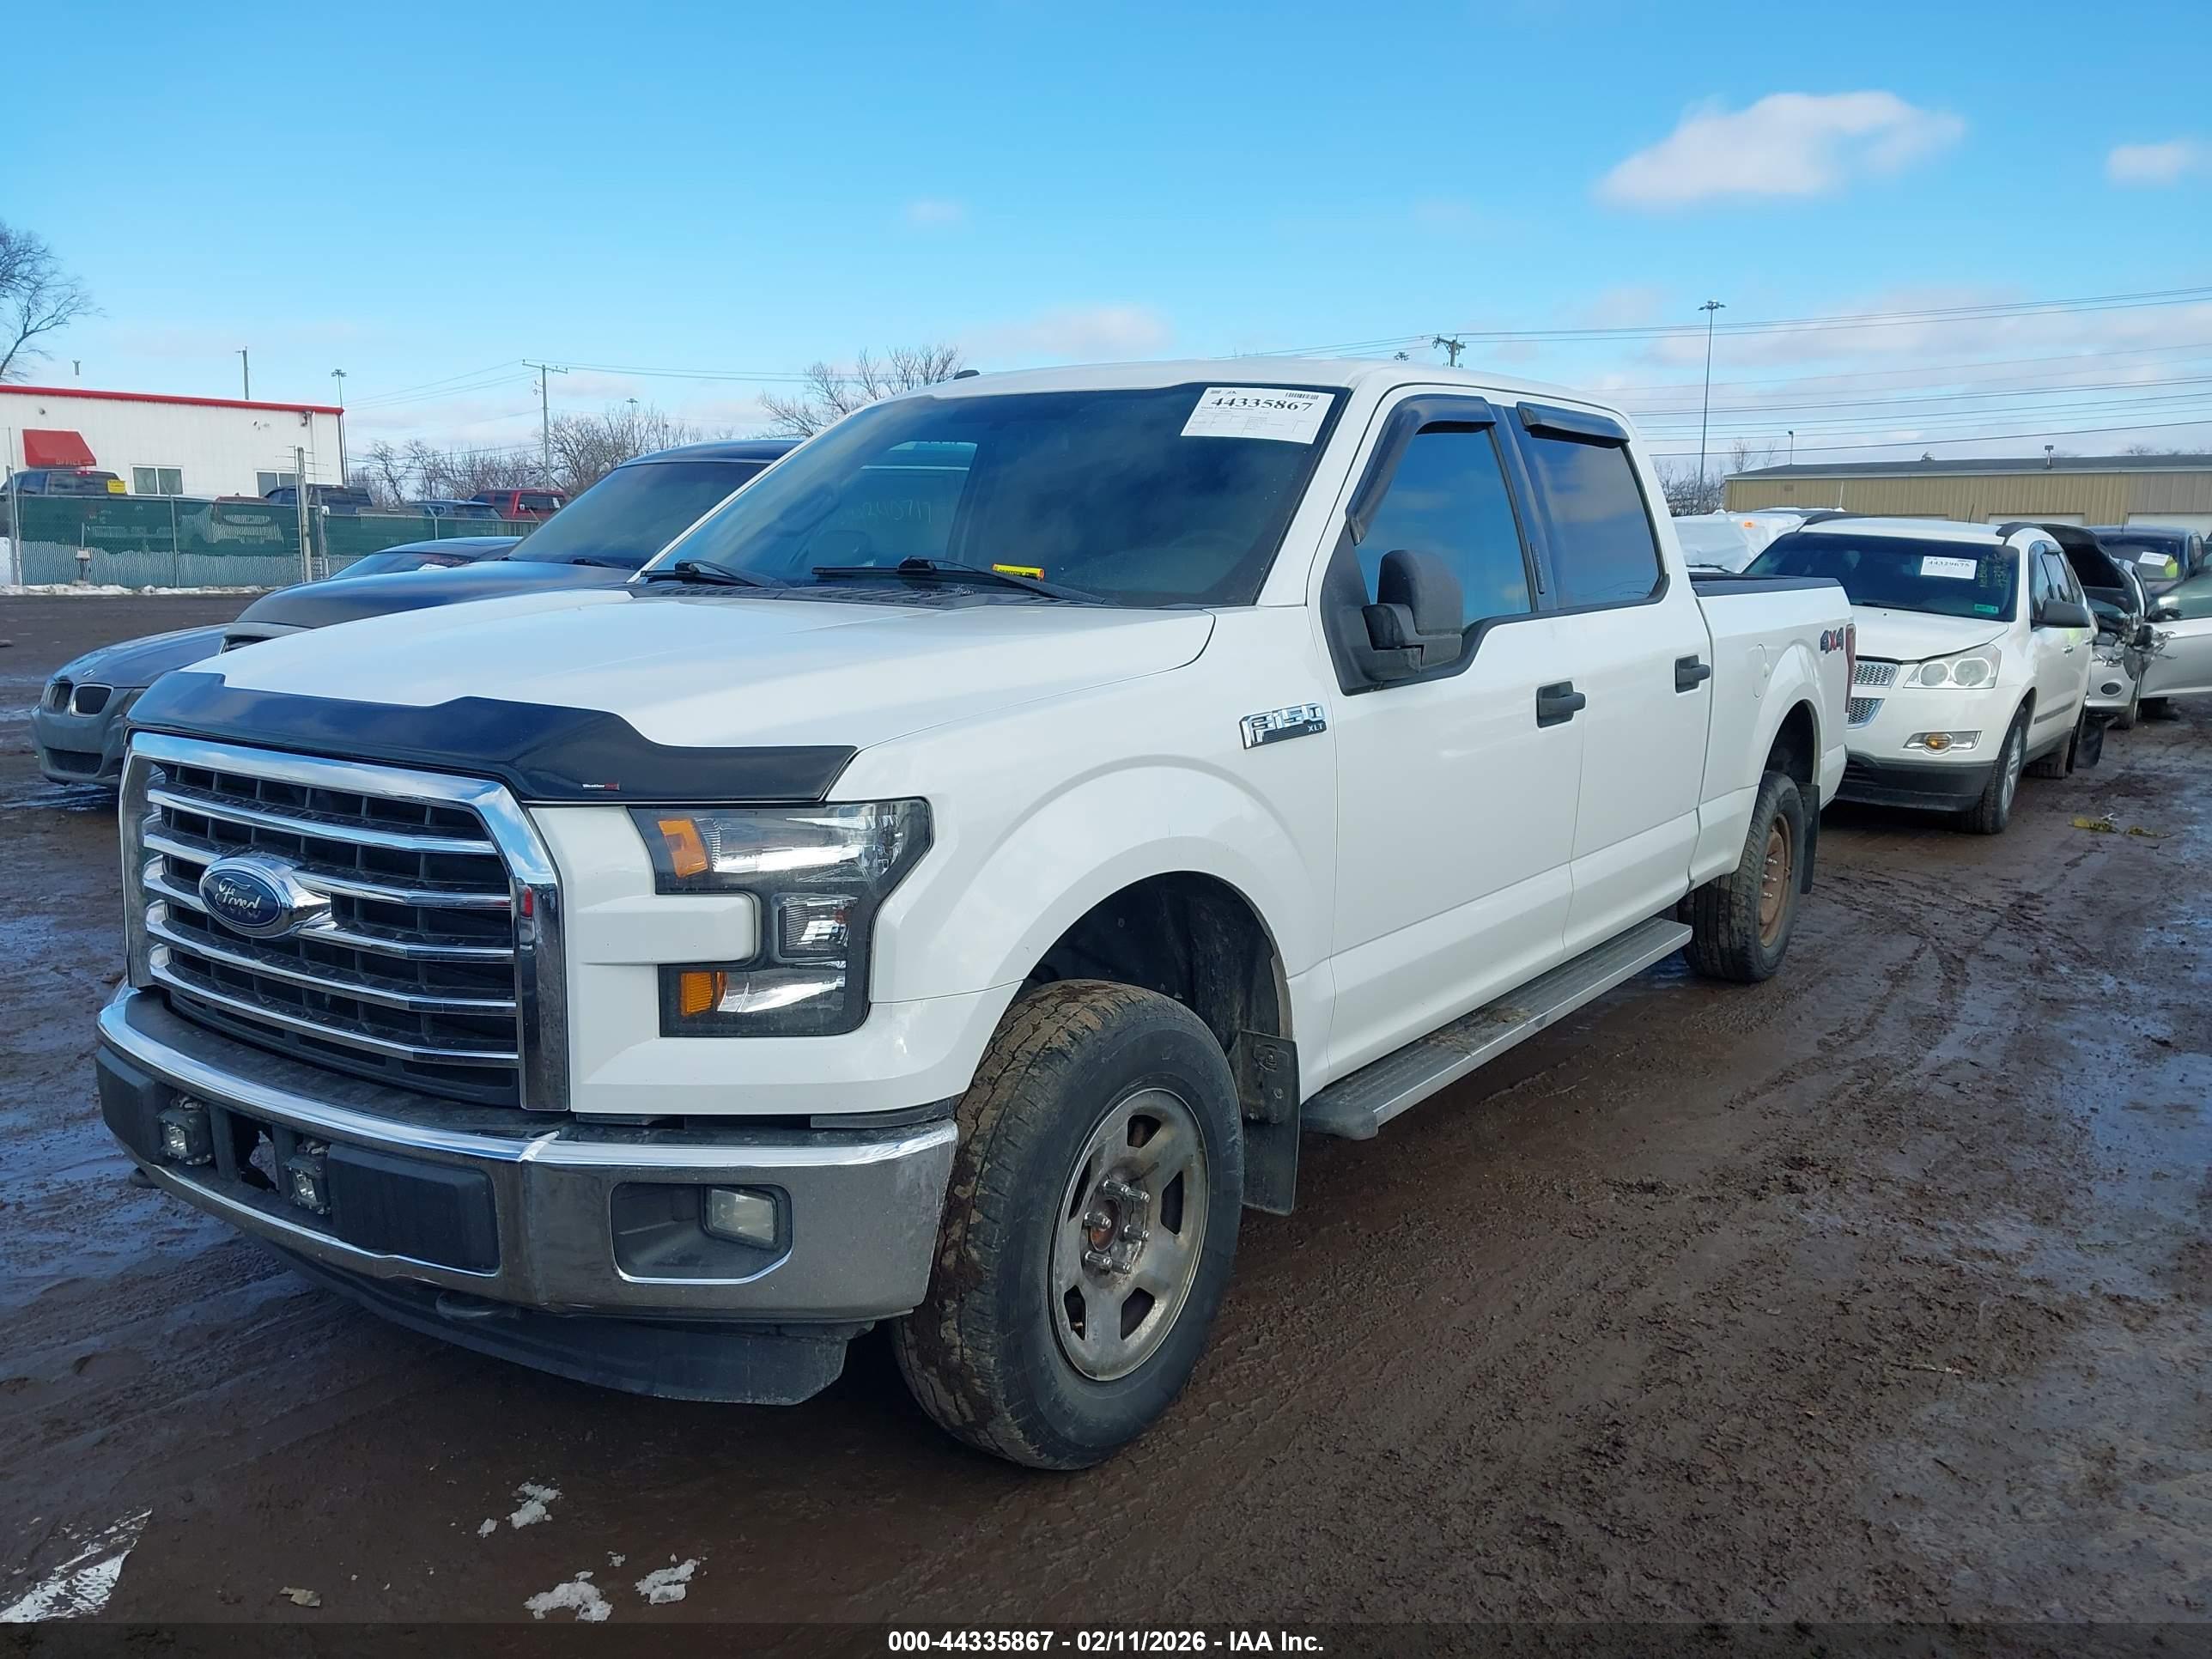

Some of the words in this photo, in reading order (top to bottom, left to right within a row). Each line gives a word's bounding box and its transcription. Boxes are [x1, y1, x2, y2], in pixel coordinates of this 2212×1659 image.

[1210, 397, 1314, 411] 44335867
[1308, 723, 1323, 732] XLT
[217, 877, 263, 909] Ford
